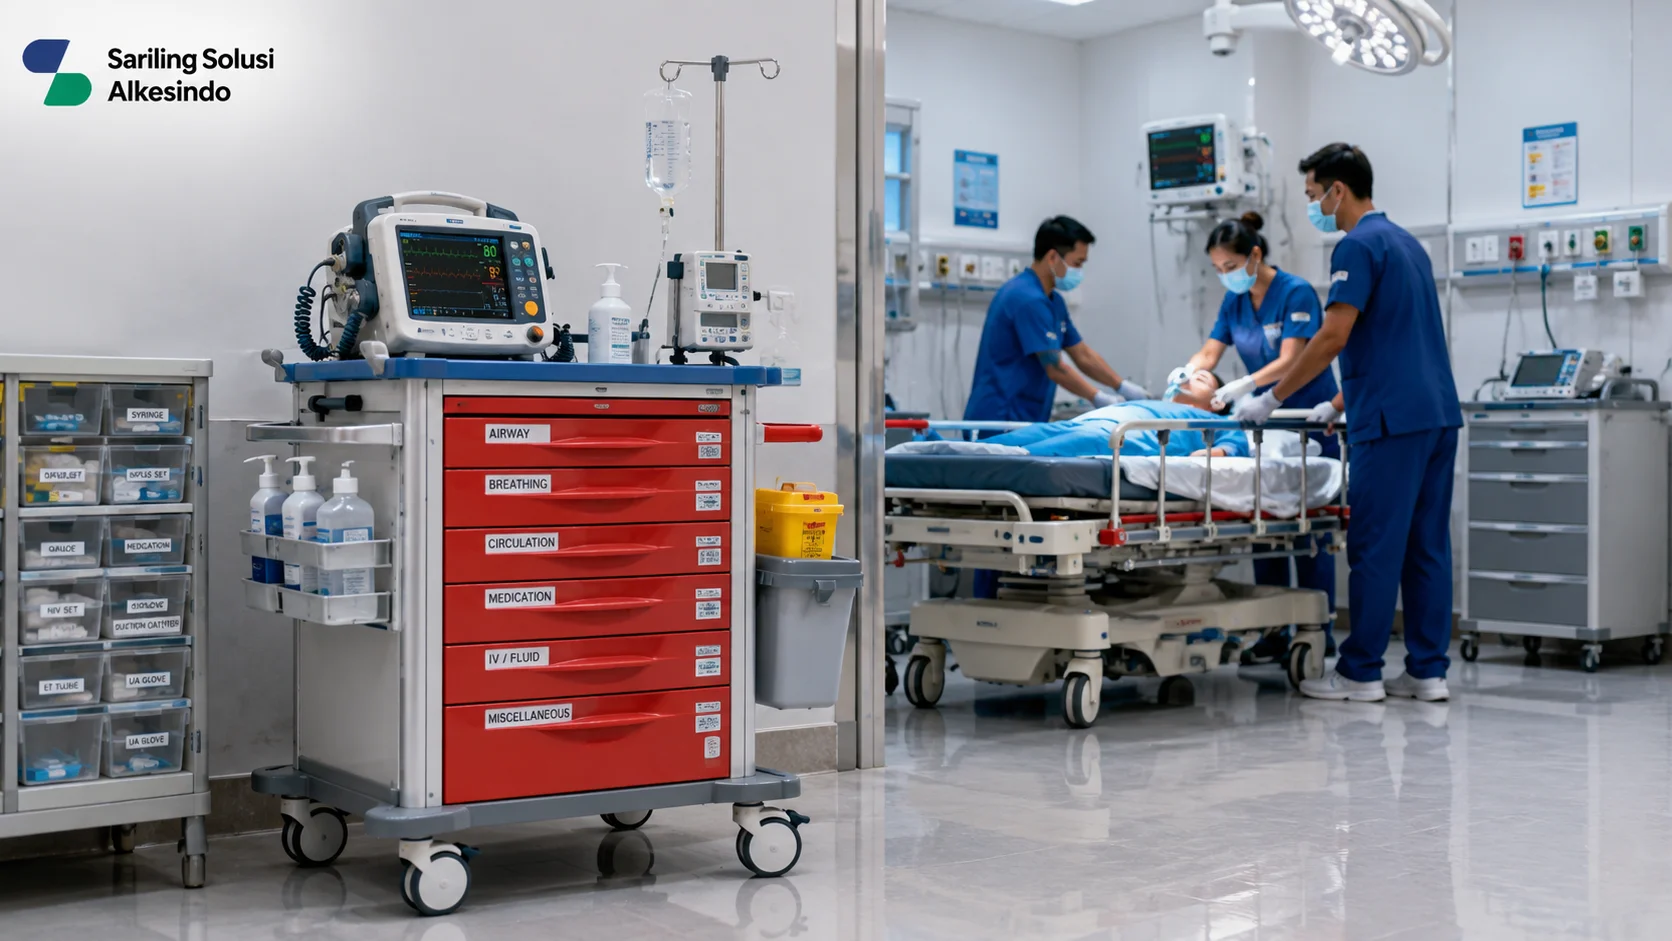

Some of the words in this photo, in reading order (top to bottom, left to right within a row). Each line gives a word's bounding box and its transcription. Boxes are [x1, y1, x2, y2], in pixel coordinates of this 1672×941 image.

[488, 428, 530, 439] AIRWAY
[488, 478, 548, 490] BREATHING
[487, 536, 556, 549] CIRCULATION
[488, 590, 552, 604] MEDICATION
[488, 653, 500, 665] IV
[510, 651, 540, 664] FLUID
[488, 707, 571, 724] MISCELLANEOUS
